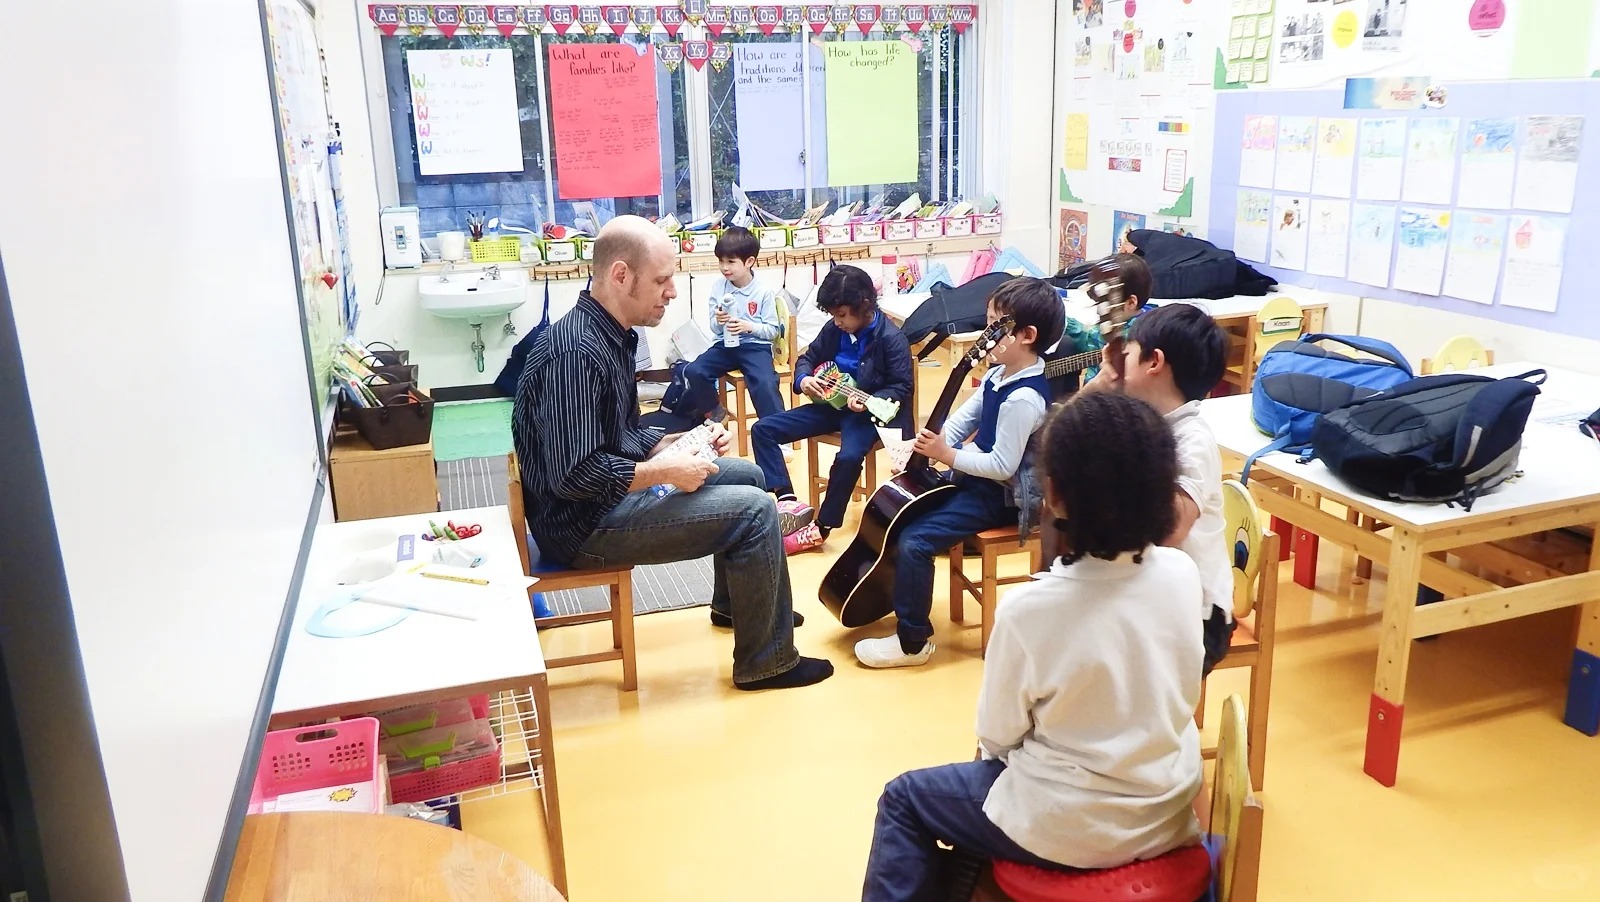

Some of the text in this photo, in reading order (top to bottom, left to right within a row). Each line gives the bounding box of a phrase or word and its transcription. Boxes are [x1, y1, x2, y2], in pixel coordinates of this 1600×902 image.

[378, 9, 397, 22] Aa
[408, 9, 426, 23] Bb
[468, 9, 485, 23] Dd
[497, 9, 513, 22] Ee
[527, 10, 542, 22] Ff
[553, 10, 570, 23] Gg
[582, 10, 599, 22] Hh
[665, 10, 679, 22] Kk
[706, 10, 726, 22] Mm
[733, 10, 748, 22] Nn
[760, 10, 775, 22] Oo
[786, 10, 800, 24] Pp
[810, 10, 825, 23] Qq
[834, 10, 847, 21] Rr
[860, 10, 873, 21] Ss
[885, 9, 897, 21] Tt
[908, 10, 922, 21] Uu
[931, 10, 946, 21] Vv
[952, 10, 971, 21] Ww
[552, 47, 620, 61] What are
[664, 43, 726, 59] Xx Yy Zz
[737, 47, 764, 61] How
[828, 43, 901, 58] How has life
[569, 60, 636, 76] families like?
[740, 62, 786, 75] traditions
[849, 56, 895, 70] changed?
[737, 75, 753, 85] and
[757, 74, 772, 84] the
